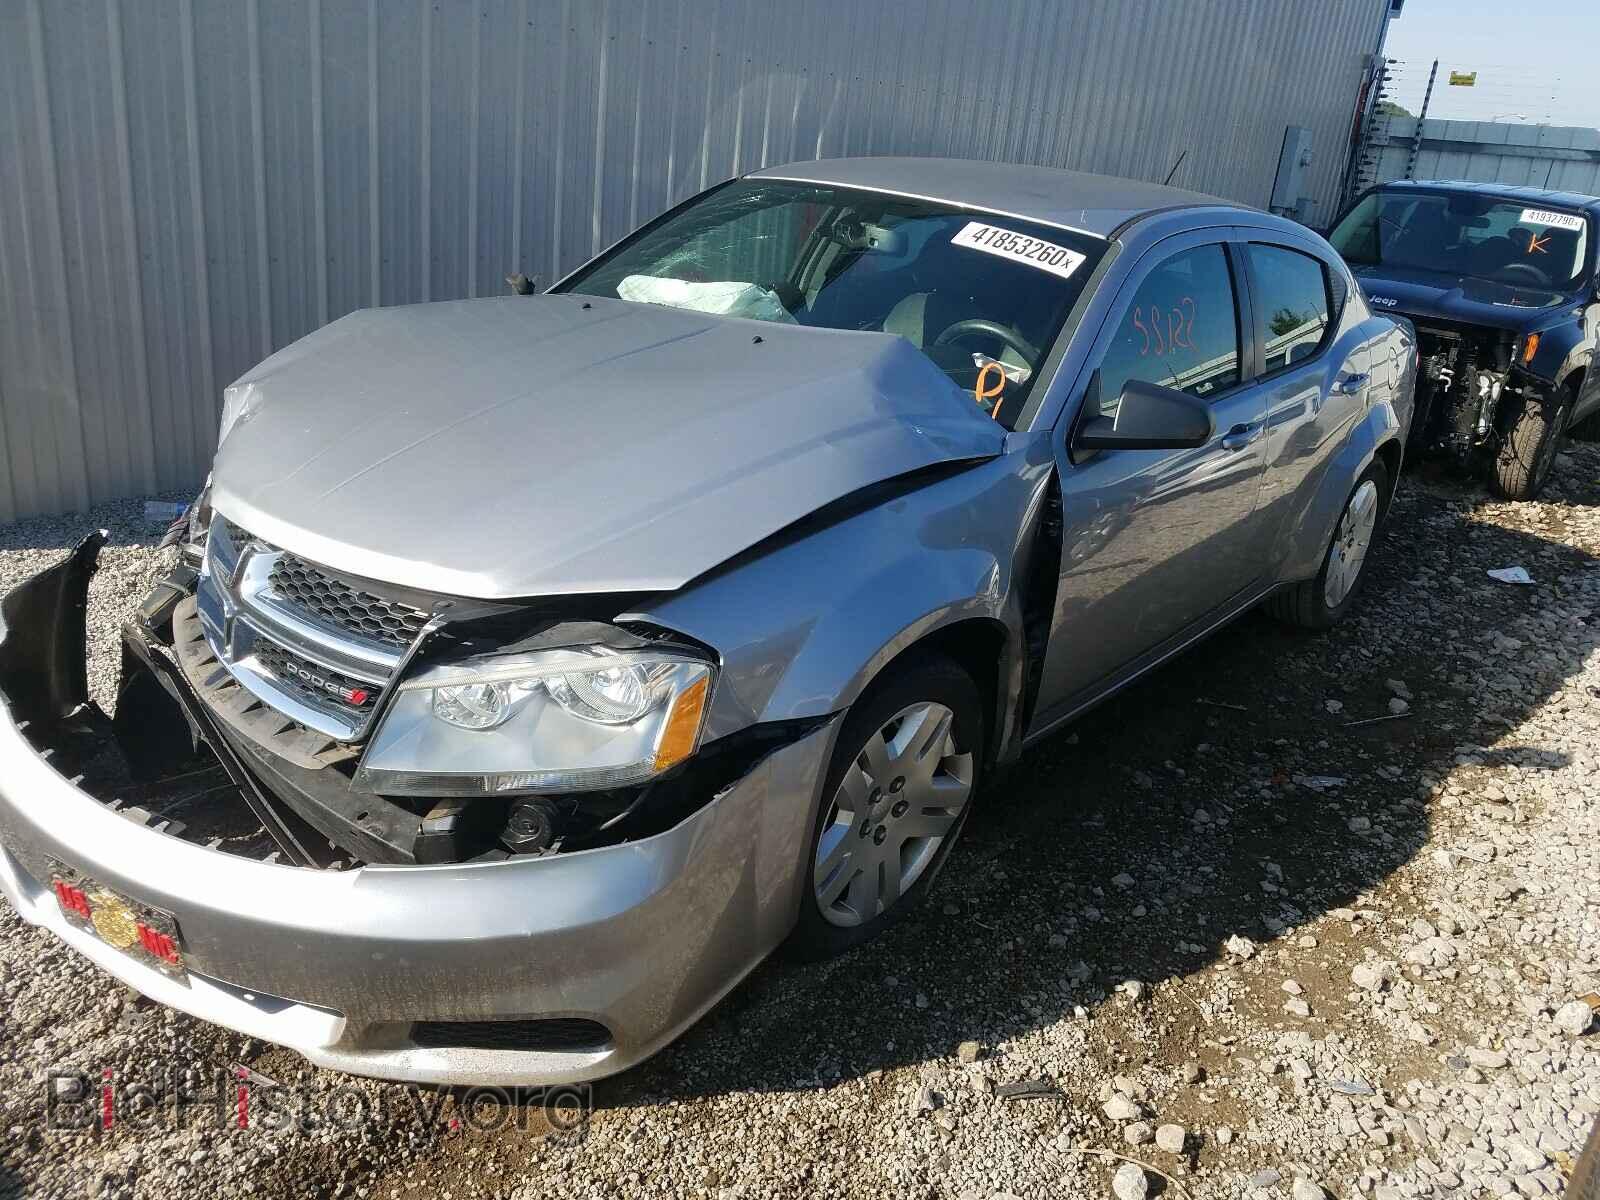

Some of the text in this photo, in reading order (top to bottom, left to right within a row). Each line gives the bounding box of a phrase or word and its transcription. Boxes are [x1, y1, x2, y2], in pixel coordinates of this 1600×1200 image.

[972, 227, 1073, 269] 41853260x
[1528, 233, 1552, 254] K
[1369, 295, 1398, 307] Jeep
[286, 662, 353, 700] DODGE
